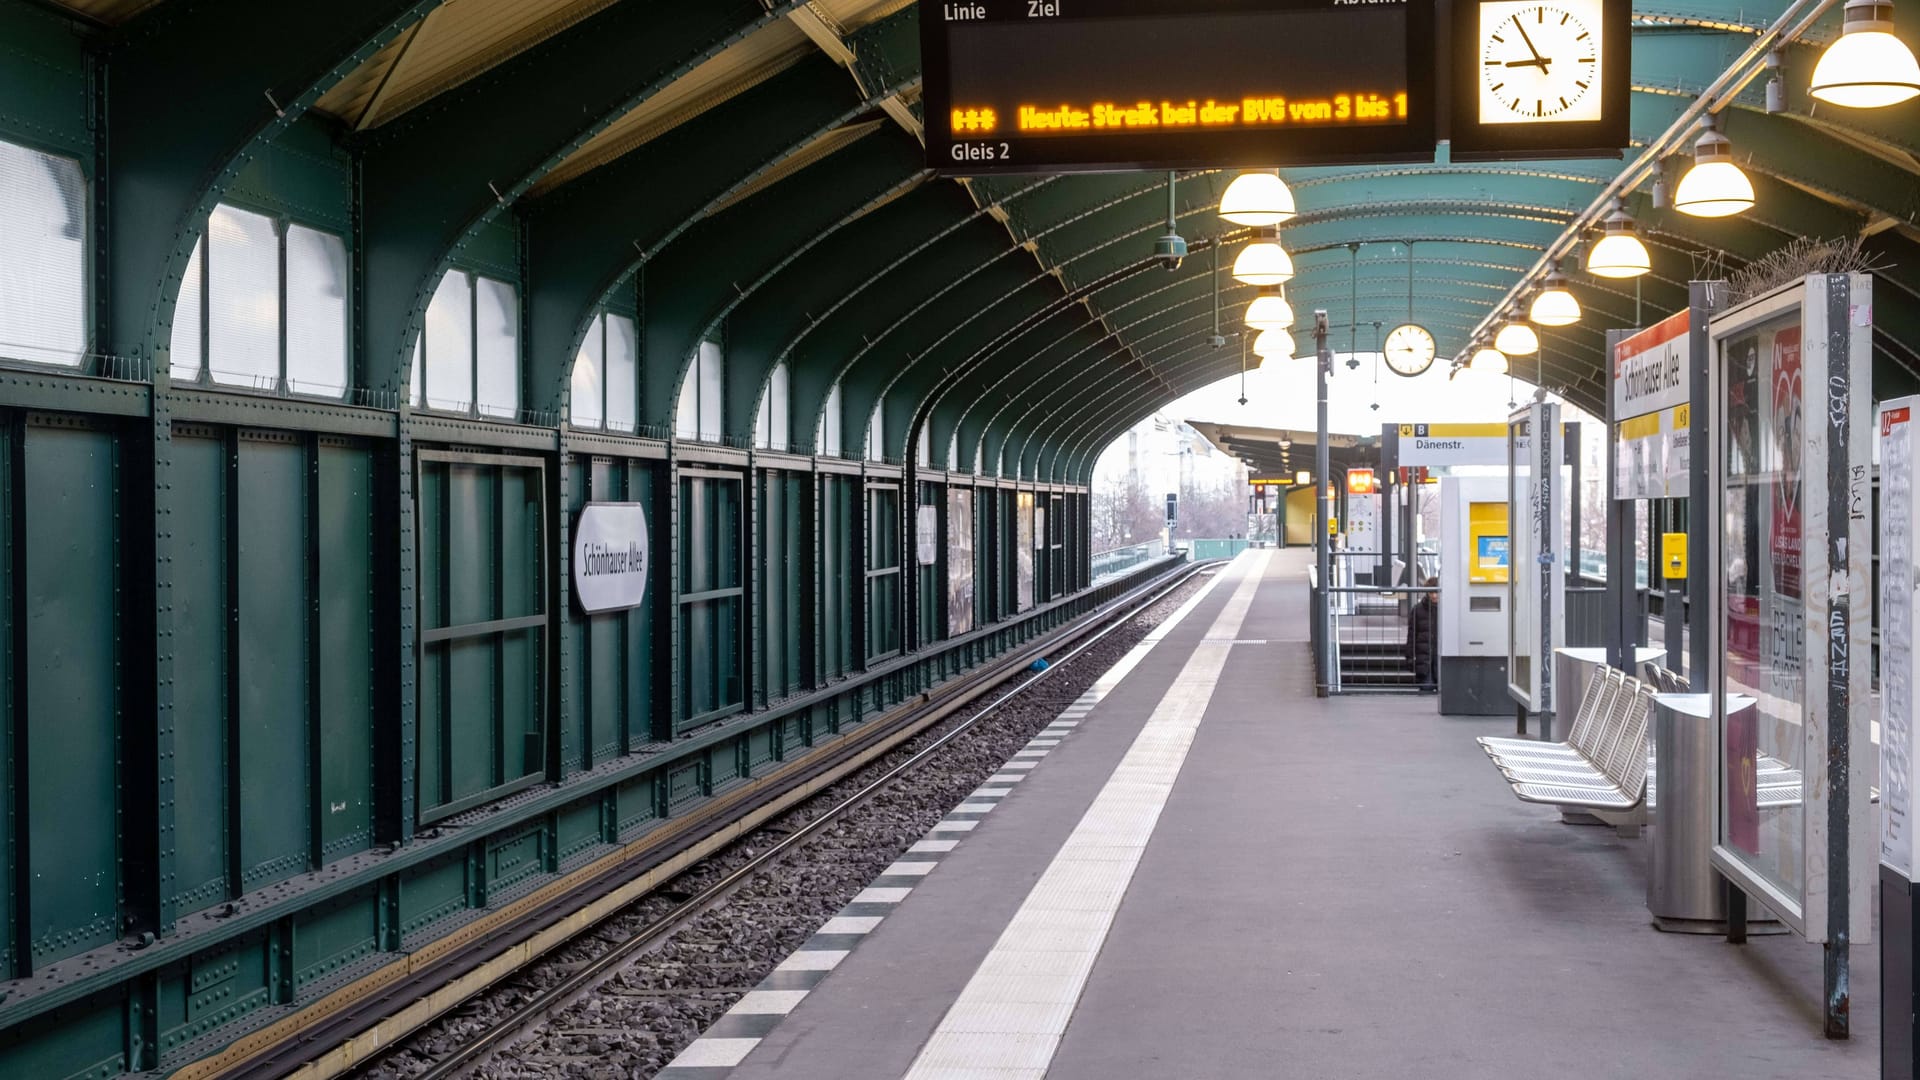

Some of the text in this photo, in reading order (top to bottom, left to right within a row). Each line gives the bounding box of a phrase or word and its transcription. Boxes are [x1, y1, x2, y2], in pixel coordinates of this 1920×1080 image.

[944, 4, 986, 21] Linie
[1027, 0, 1060, 17] Ziel
[1018, 105, 1090, 129] Heute:
[1092, 102, 1159, 127] Streik
[1161, 101, 1196, 125] bei
[1199, 100, 1239, 124] der
[1242, 97, 1285, 122] BVG
[1289, 101, 1331, 120] von
[1334, 95, 1350, 118] 3
[1355, 94, 1389, 118] bis
[951, 142, 1010, 161] Gleis 2
[1624, 343, 1680, 402] Schönhauser Allee
[1417, 425, 1425, 435] B
[1416, 438, 1465, 450] Dänenstr.
[583, 540, 643, 577] Schönhauser Allee
